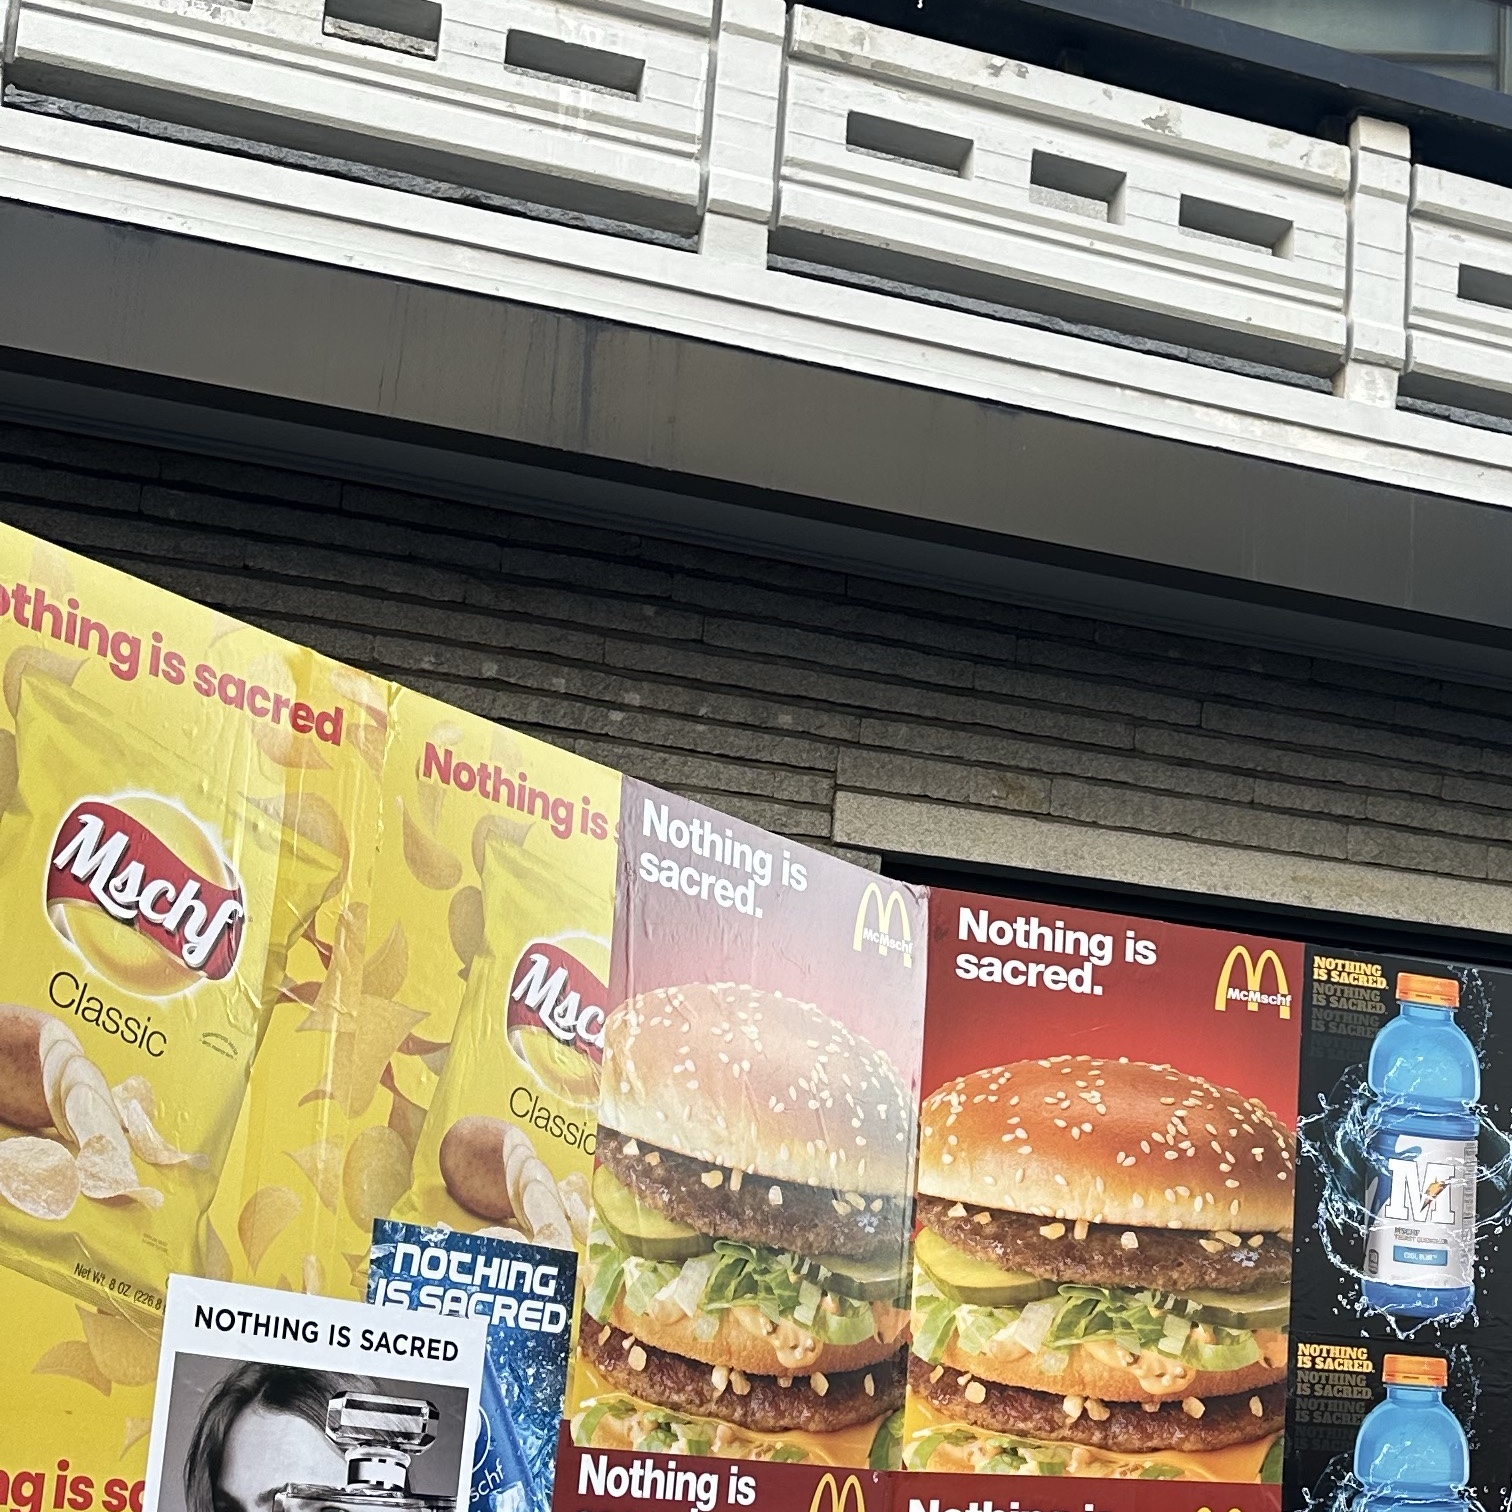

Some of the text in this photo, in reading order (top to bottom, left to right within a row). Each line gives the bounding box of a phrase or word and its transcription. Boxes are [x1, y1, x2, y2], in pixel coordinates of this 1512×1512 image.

[149, 631, 186, 687] is
[194, 660, 344, 747] sacred
[422, 742, 610, 841] Nothing is
[642, 798, 809, 892] Nothing is
[53, 812, 244, 966] Mschf
[639, 851, 764, 920] sacred.
[958, 906, 1158, 967] Nothing is
[955, 951, 1104, 995] sacred.
[1313, 956, 1382, 976] NOTHING
[1313, 968, 1390, 990] IS SACRED.
[48, 970, 167, 1060] Classic
[1227, 987, 1293, 1009] McMschf
[74, 1262, 92, 1280] Net
[109, 1278, 117, 1290] 8
[393, 1242, 558, 1297] NOTHING
[194, 1305, 459, 1361] NOTHING IS SACRED
[375, 1278, 567, 1334] IS SACRED
[1297, 1343, 1368, 1360] NOTHING
[1297, 1356, 1376, 1373] IS SACRED.
[53, 1458, 95, 1511] is
[577, 1453, 757, 1511] Nothing is
